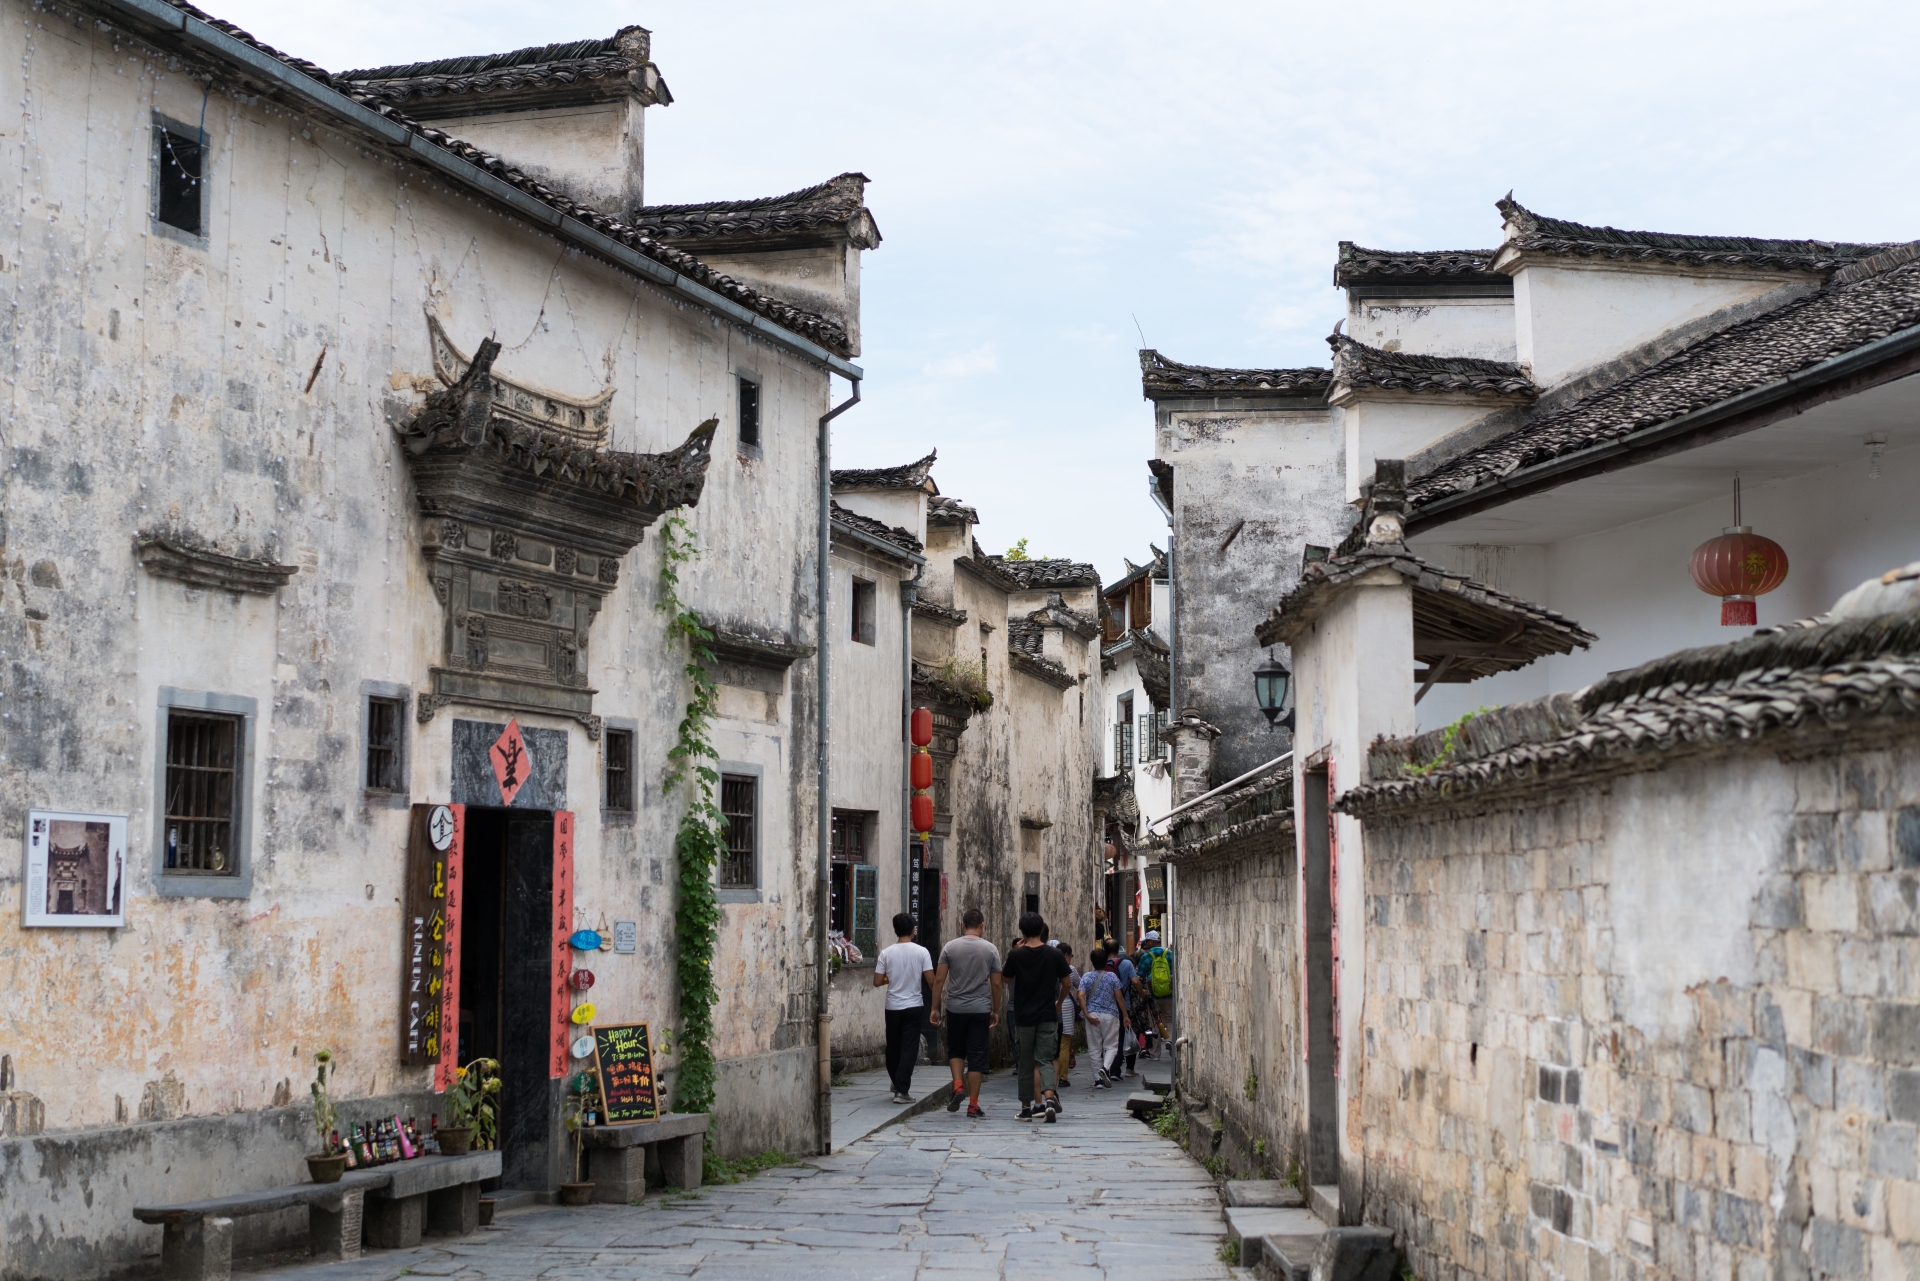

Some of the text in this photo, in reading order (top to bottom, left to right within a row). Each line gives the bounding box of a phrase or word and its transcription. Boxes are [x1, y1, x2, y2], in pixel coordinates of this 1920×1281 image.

[496, 735, 523, 793] 春
[408, 917, 424, 1054] KUNLUN CAFE
[608, 1027, 633, 1043] Happy
[616, 1039, 638, 1053] Hour
